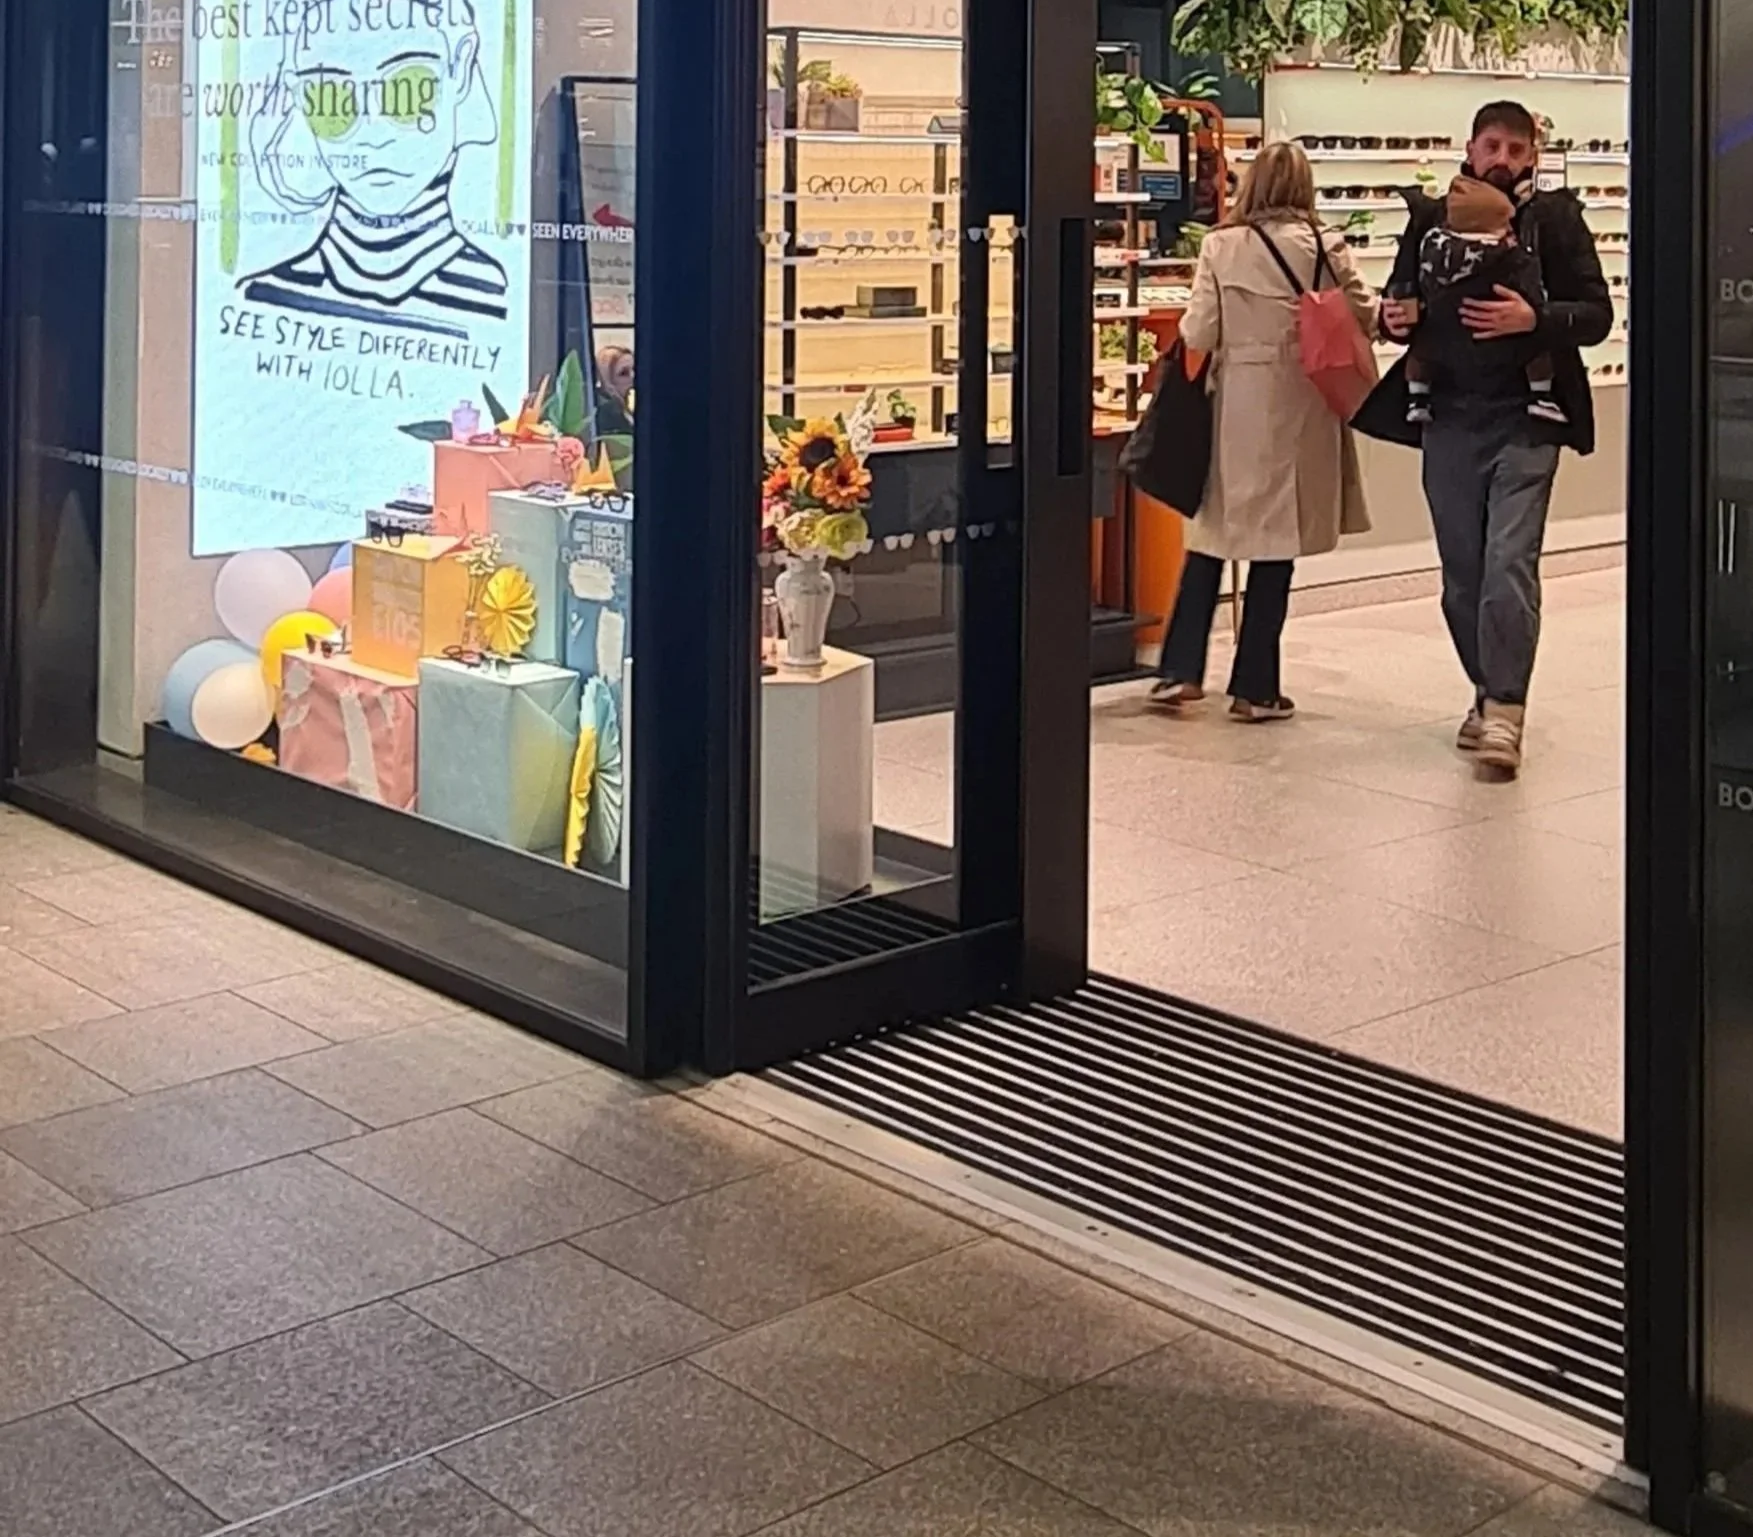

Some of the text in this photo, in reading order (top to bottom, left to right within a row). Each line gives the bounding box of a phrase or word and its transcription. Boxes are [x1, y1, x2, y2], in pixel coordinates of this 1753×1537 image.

[203, 70, 293, 119] worth
[302, 63, 440, 134] sharing
[229, 153, 304, 169] COLTION
[327, 154, 369, 170] STORE
[532, 223, 559, 240] SEEN
[219, 305, 502, 373] SEE STYLE DIFFERENTLY
[256, 351, 312, 382] WITH
